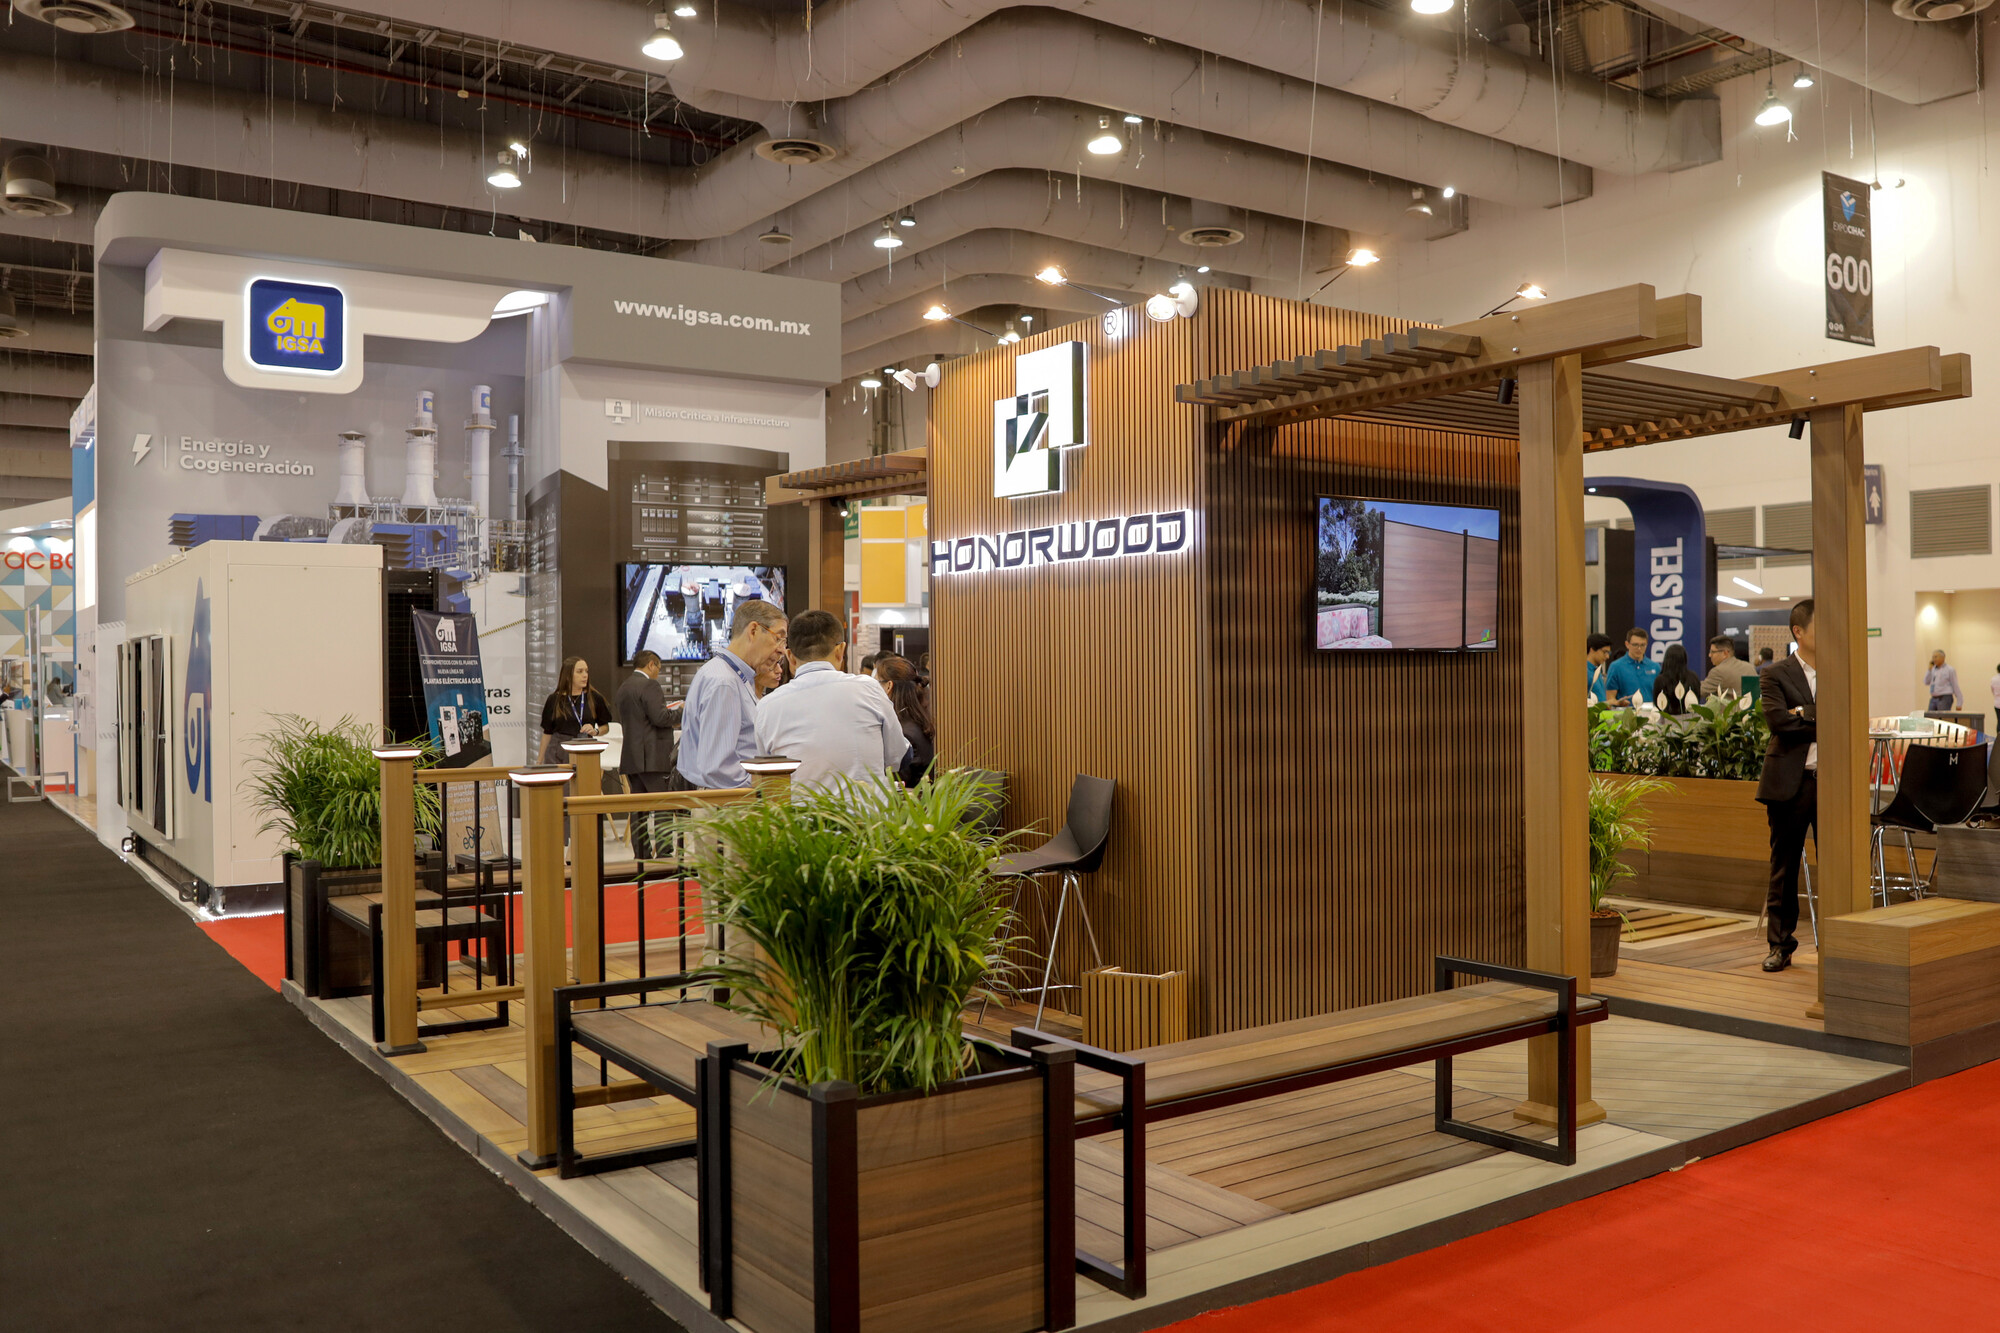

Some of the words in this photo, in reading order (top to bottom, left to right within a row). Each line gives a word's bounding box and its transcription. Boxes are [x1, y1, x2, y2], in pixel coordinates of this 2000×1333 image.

[1827, 252, 1871, 296] 600
[614, 300, 811, 336] www.igsa.com.mx
[277, 335, 325, 354] IGSA
[721, 414, 790, 427] Infraestructura
[180, 436, 255, 457] Energía
[258, 444, 271, 459] y
[180, 454, 314, 476] Cogeneración
[931, 509, 1188, 576] HONORWOOD
[440, 641, 458, 653] IGSA
